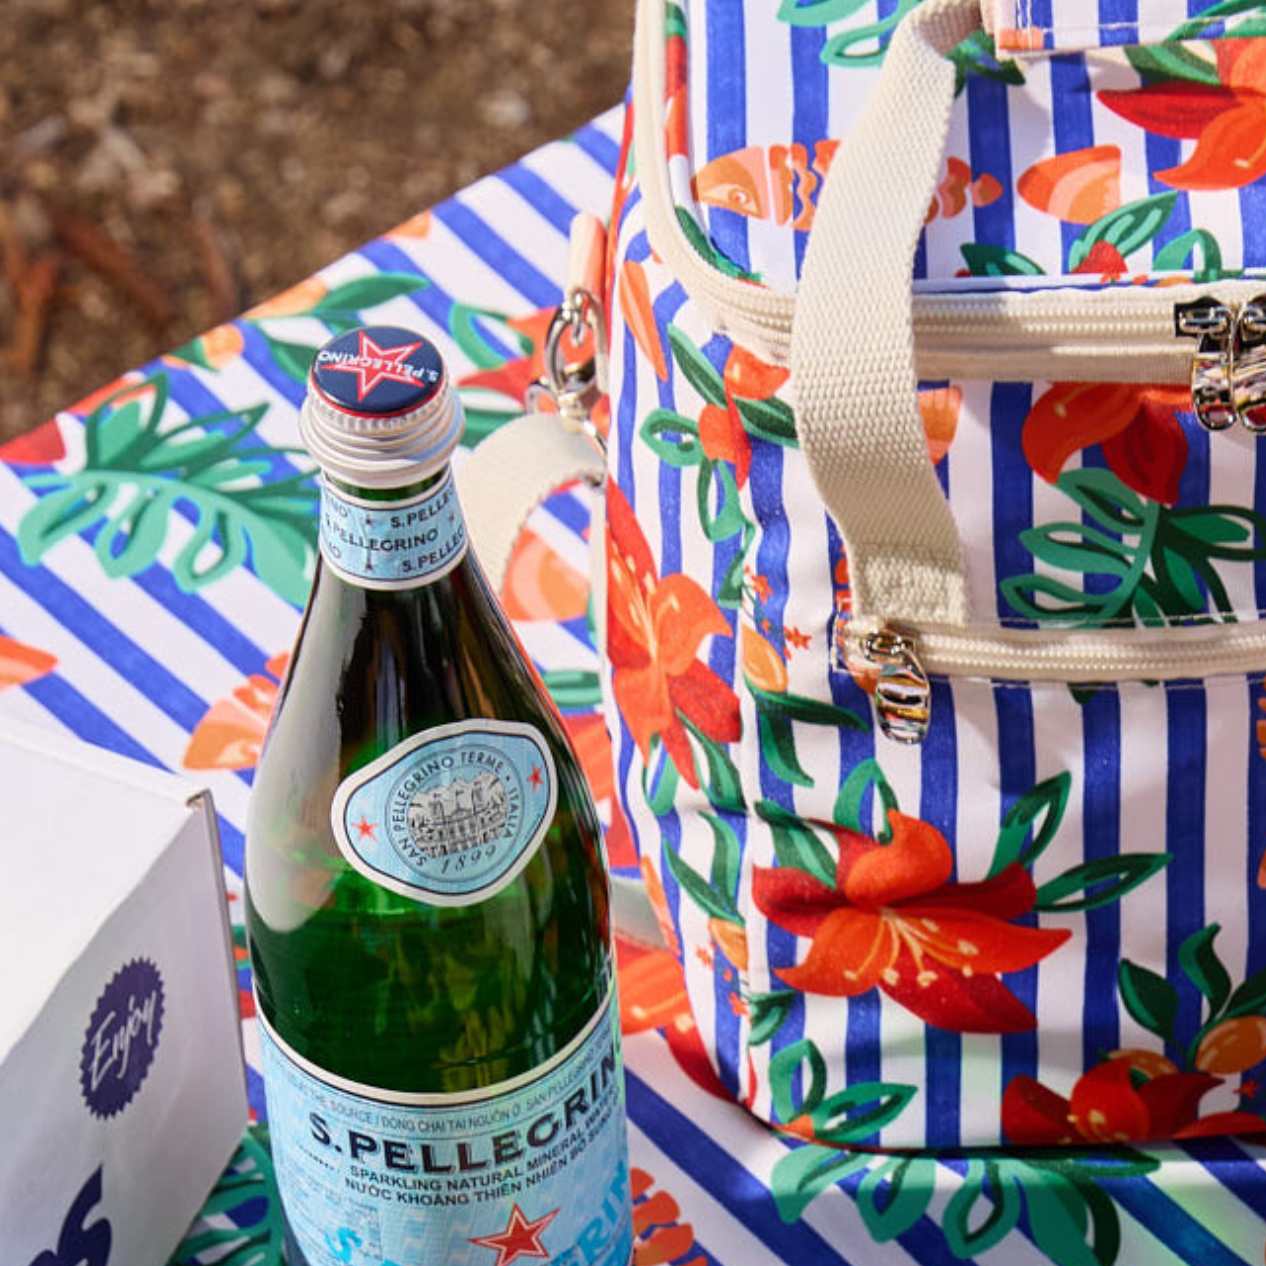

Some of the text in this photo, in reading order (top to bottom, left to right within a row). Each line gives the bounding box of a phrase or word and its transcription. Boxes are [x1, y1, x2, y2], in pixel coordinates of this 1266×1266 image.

[391, 750, 522, 867] SAN PELLEGRINO TERME ITALIA
[440, 844, 498, 875] 1899
[89, 990, 156, 1092] Enjoy
[350, 1164, 441, 1193] SPARKLING
[446, 1163, 525, 1192] NATURAL
[526, 1127, 586, 1171] MINERAL
